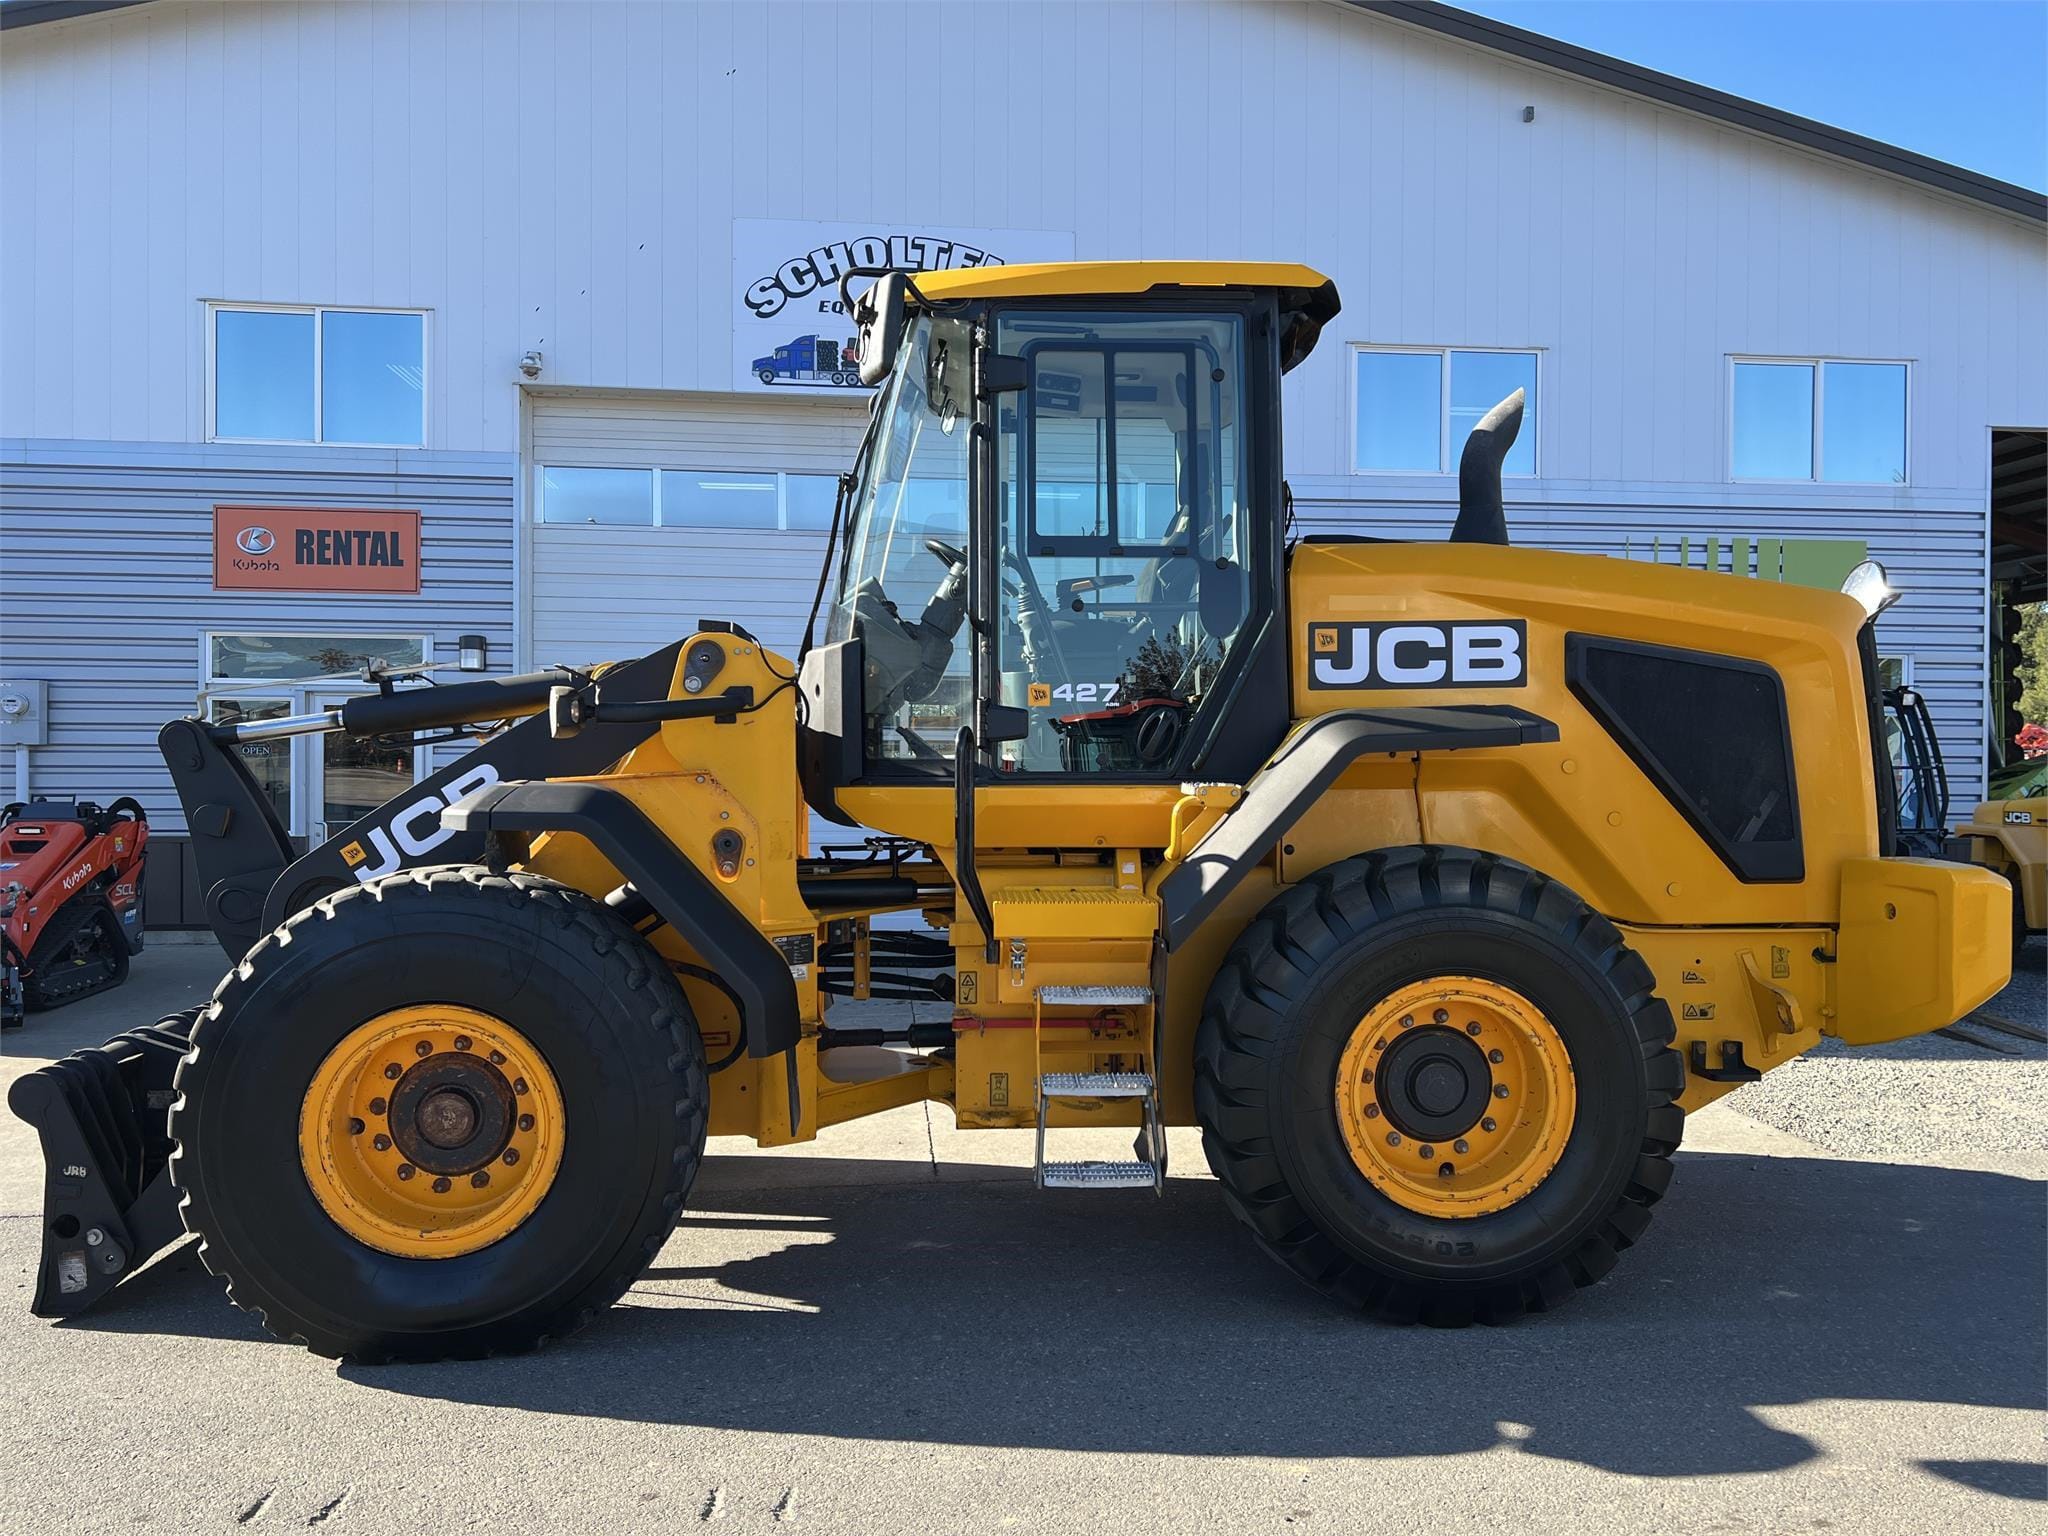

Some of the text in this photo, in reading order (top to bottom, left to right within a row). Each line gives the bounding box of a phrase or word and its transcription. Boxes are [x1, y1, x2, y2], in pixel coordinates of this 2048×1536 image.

[744, 236, 1005, 319] SCHOLTE
[295, 529, 404, 567] RENTAL
[233, 559, 280, 571] Kubota
[1315, 626, 1522, 684] JCB
[1052, 683, 1120, 702] 427
[242, 746, 270, 755] OPEN
[2004, 812, 2031, 823] JCB
[63, 863, 92, 890] Kubota
[115, 884, 134, 897] SCL
